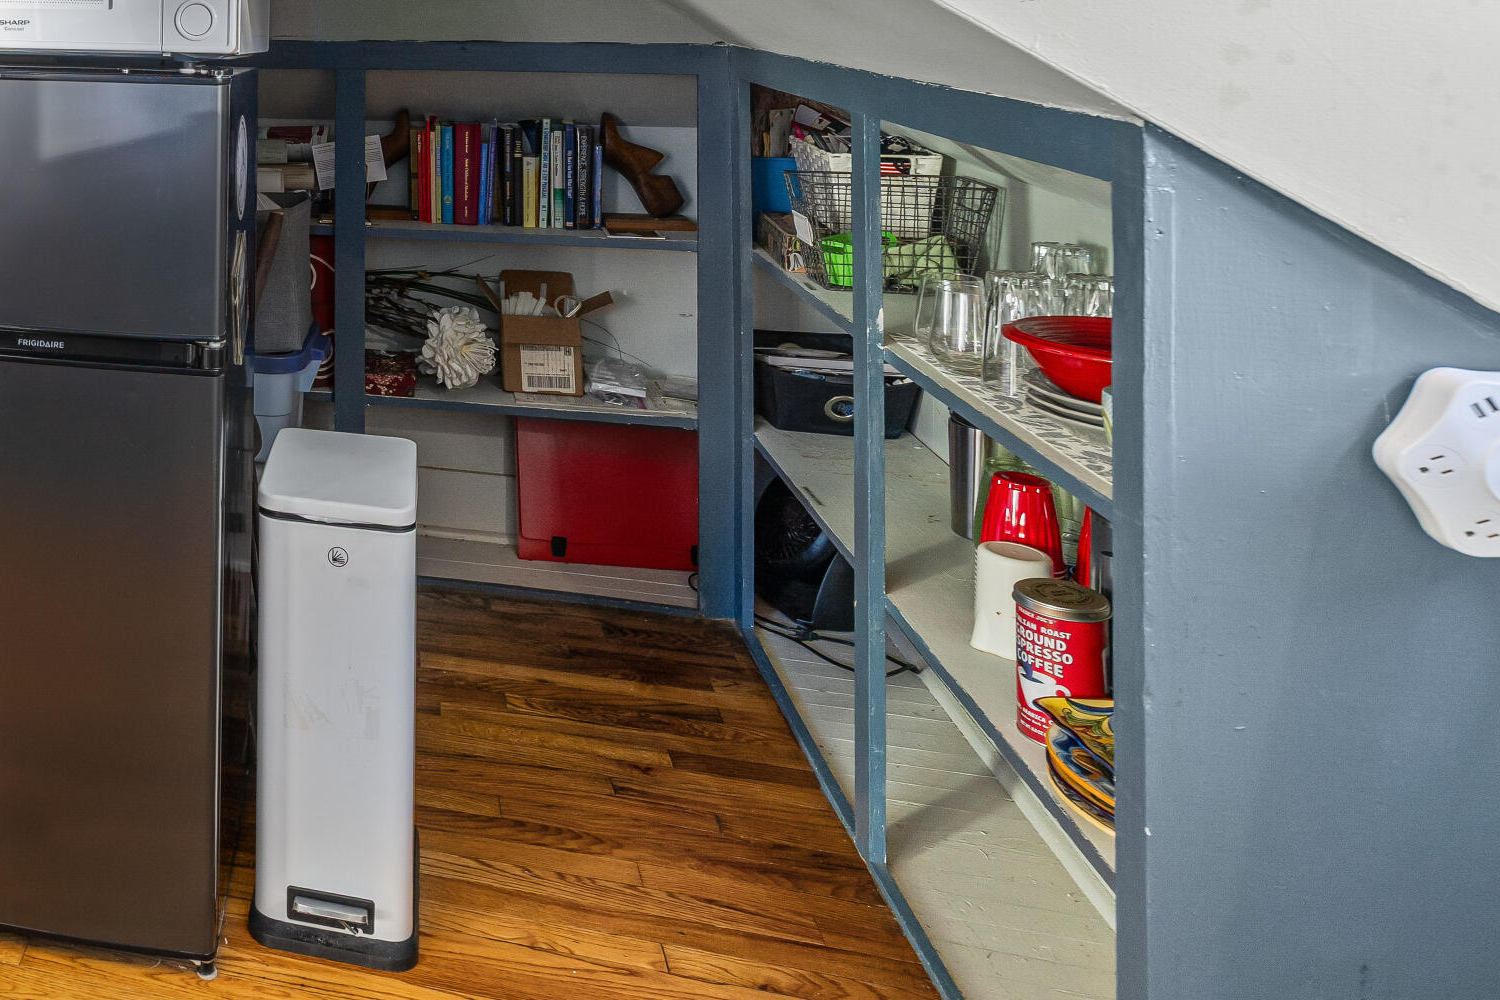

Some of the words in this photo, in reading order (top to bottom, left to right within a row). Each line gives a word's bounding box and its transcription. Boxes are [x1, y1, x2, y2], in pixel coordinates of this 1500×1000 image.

[579, 201, 587, 216] HOPE
[17, 338, 65, 349] FRIGIDAIRE
[1040, 626, 1072, 640] ROAST
[1017, 635, 1074, 665] SPRESSO
[1017, 647, 1064, 679] COFFEE
